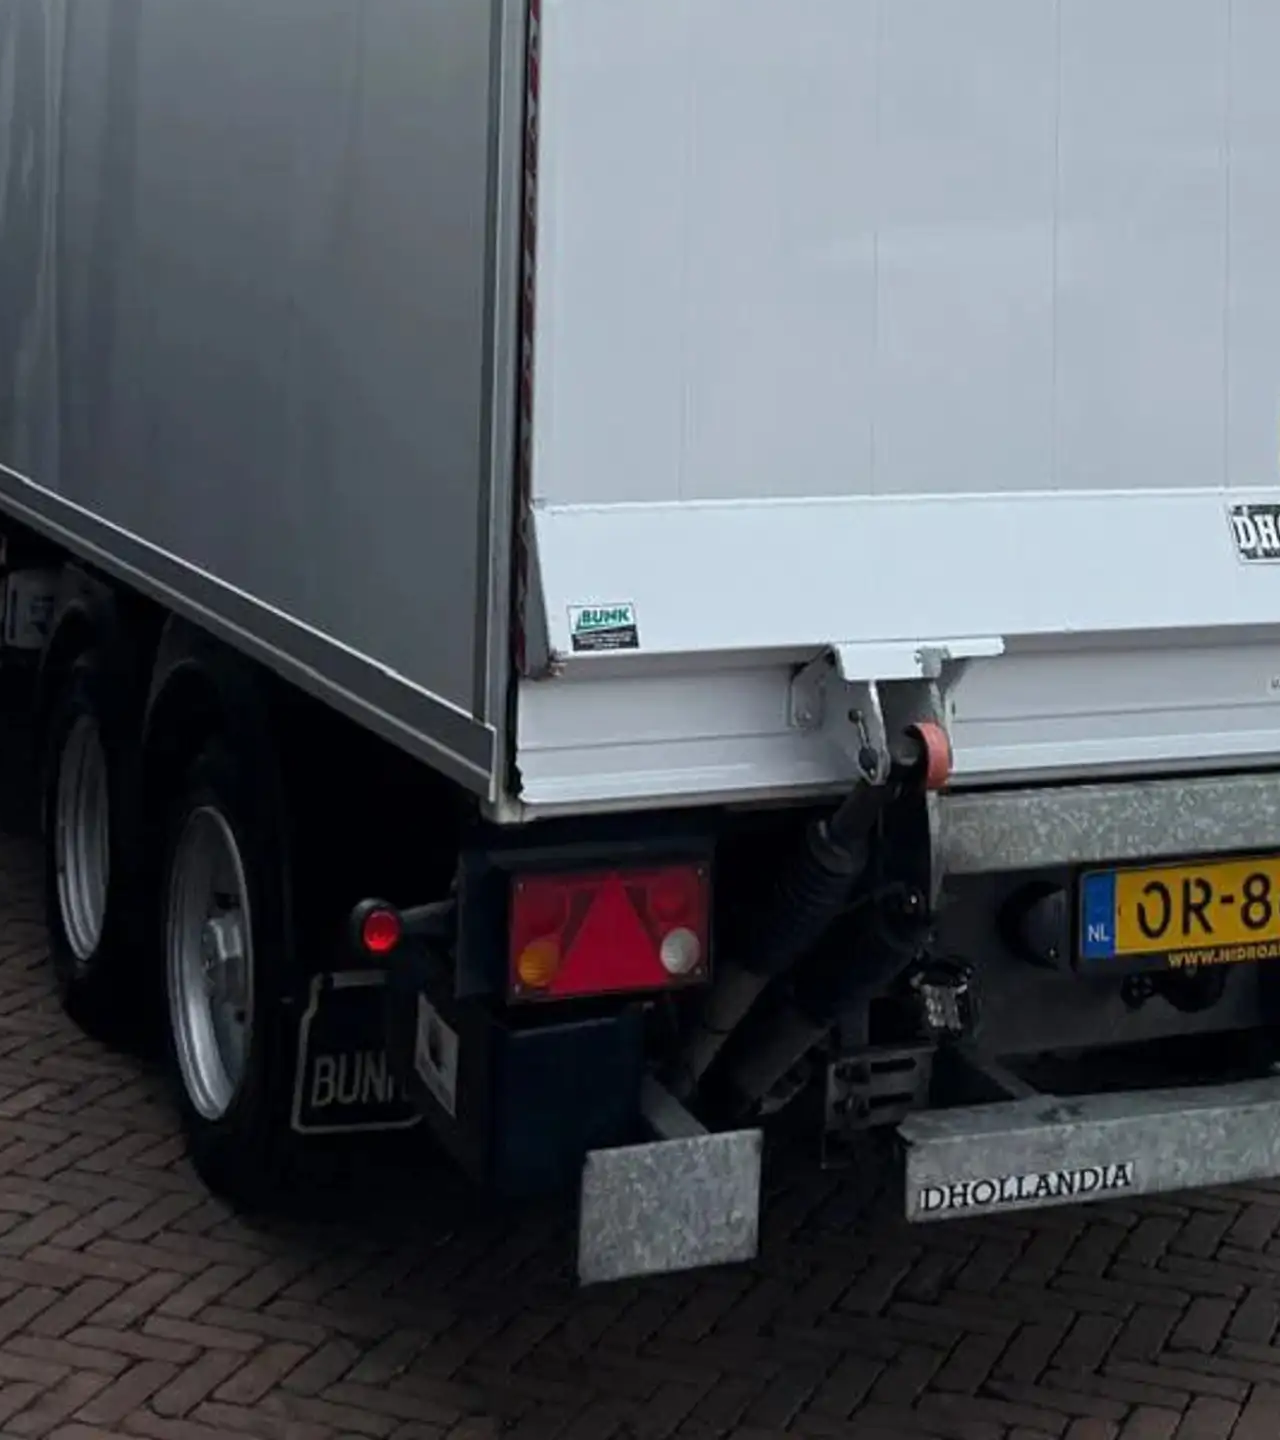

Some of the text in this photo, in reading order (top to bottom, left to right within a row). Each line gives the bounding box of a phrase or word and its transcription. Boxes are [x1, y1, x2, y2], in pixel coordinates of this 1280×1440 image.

[1088, 924, 1111, 942] NL
[311, 1050, 407, 1108] BUN
[921, 1163, 1134, 1211] DHOLLANDIA
